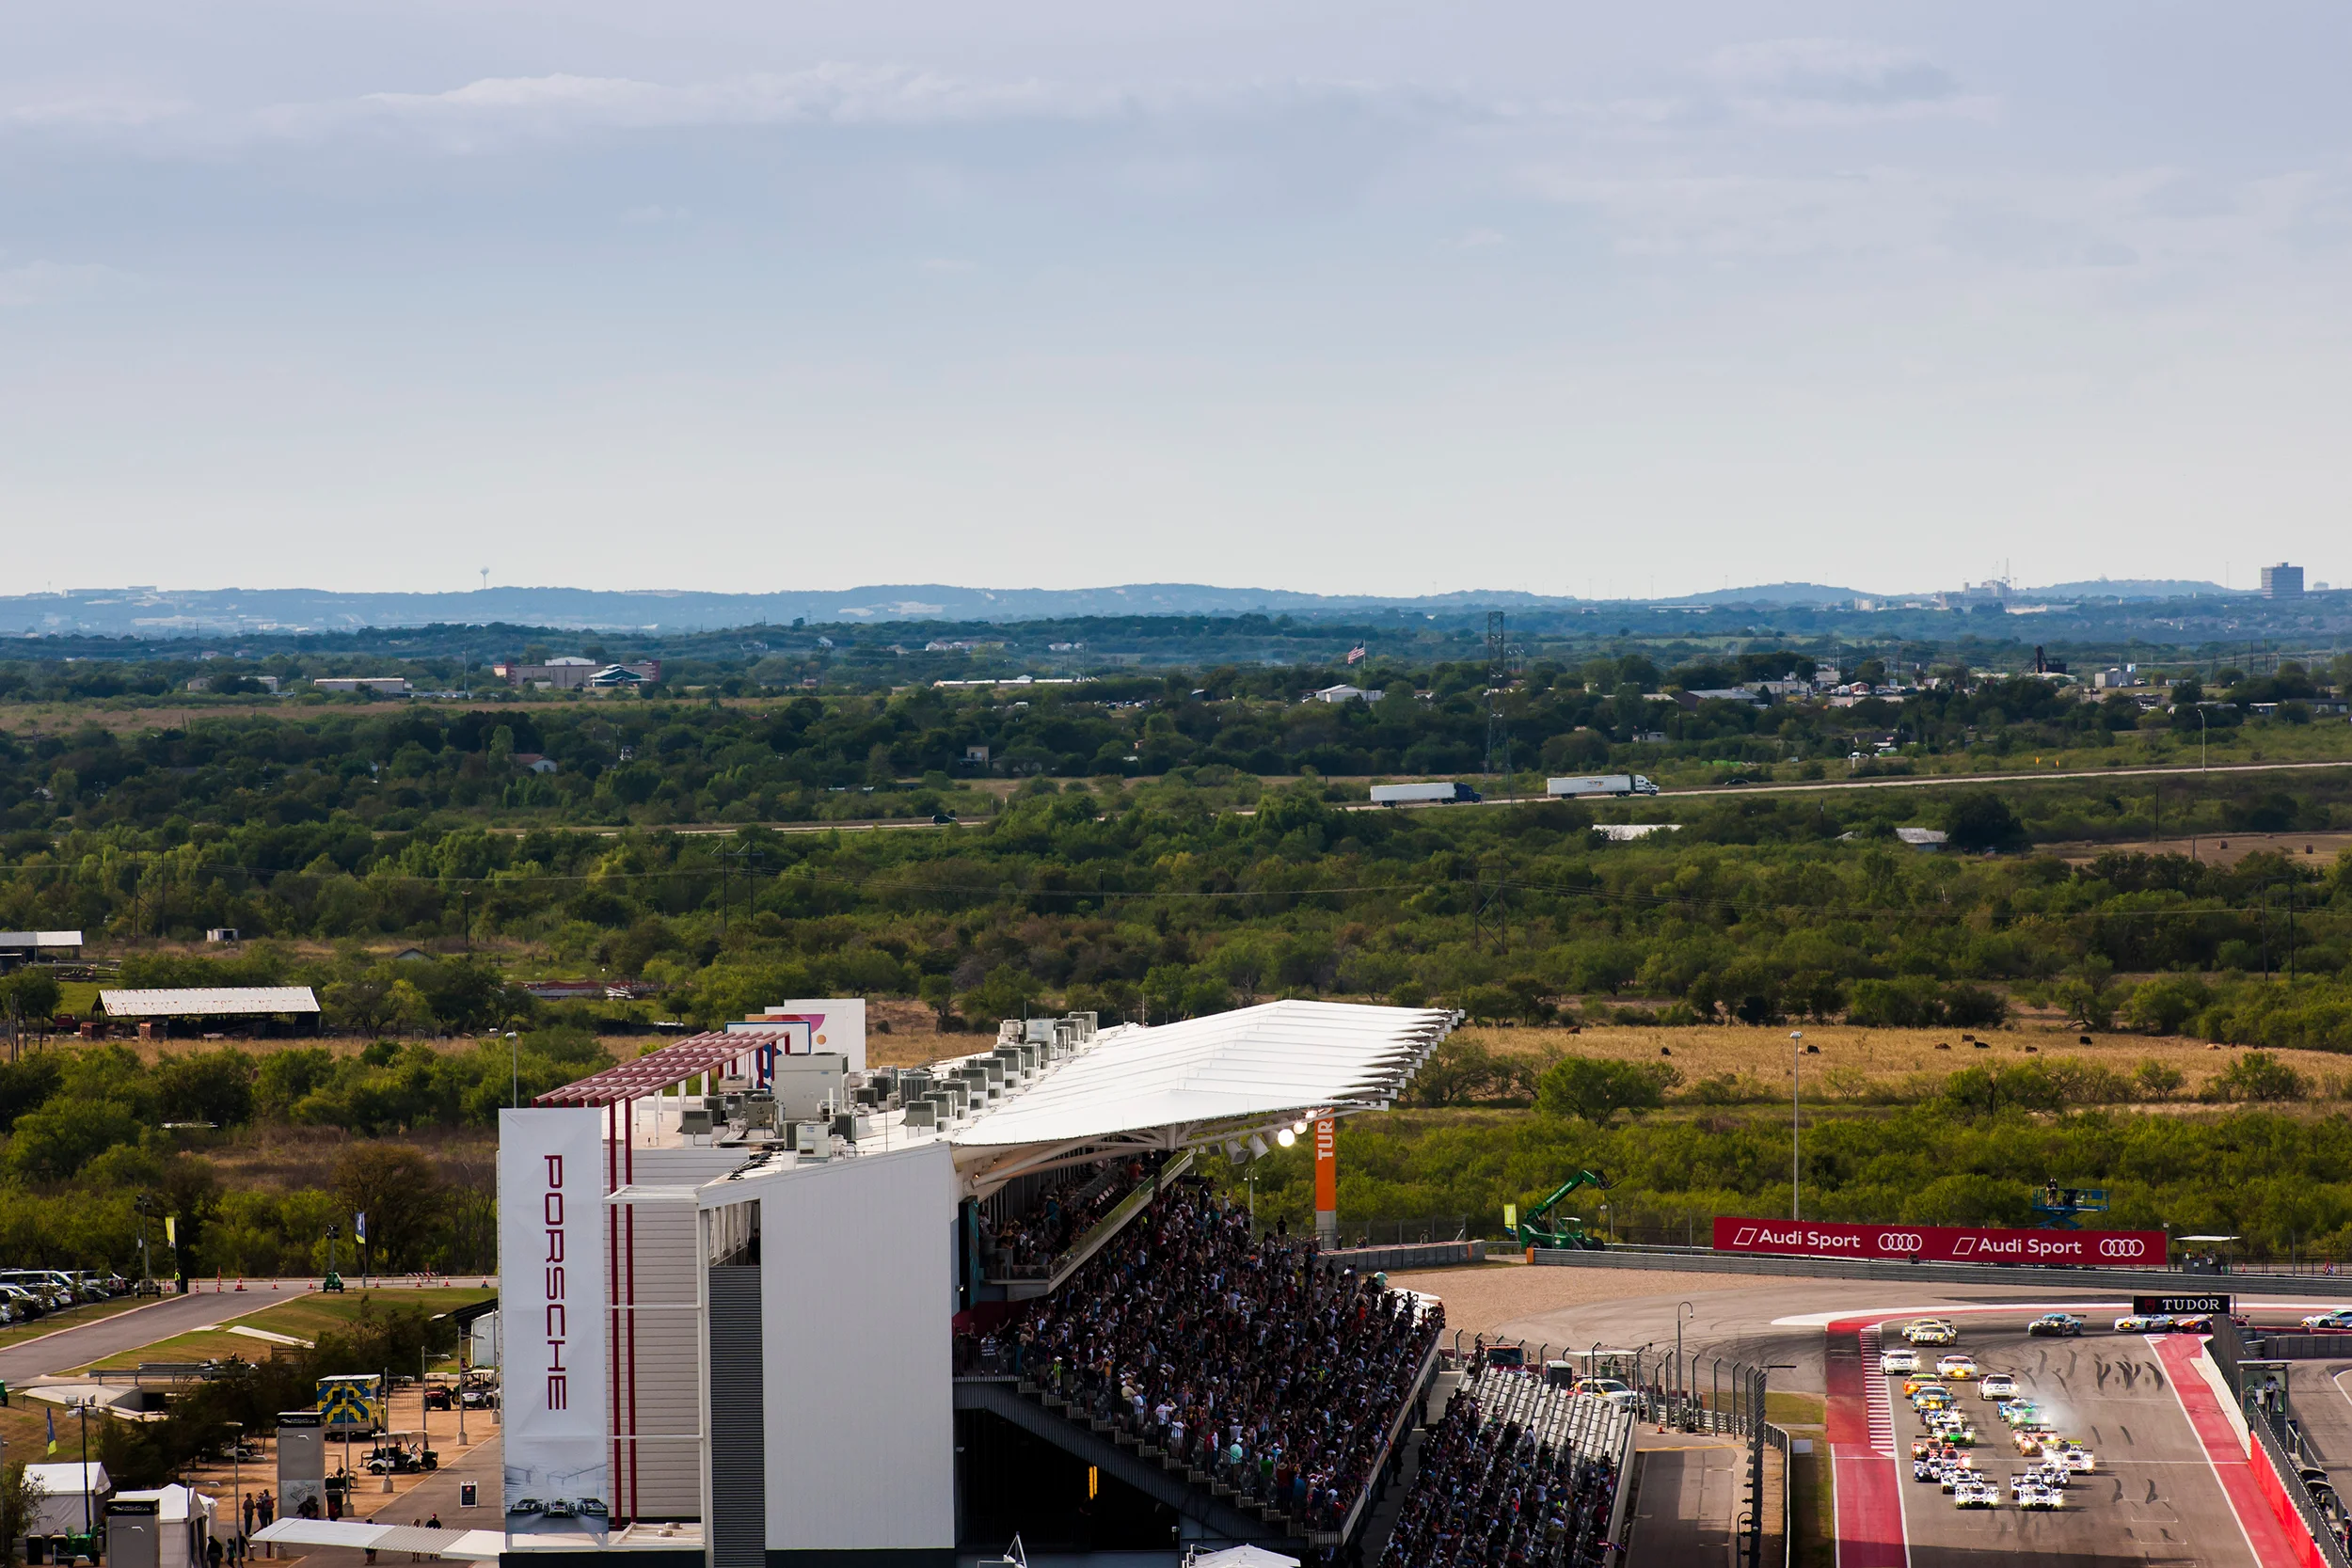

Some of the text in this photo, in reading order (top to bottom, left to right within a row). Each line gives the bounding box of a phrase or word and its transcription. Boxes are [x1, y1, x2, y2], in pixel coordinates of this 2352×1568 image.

[1758, 1228, 1861, 1249] Audi Sport
[1979, 1238, 2082, 1257] Audi Sport
[544, 1154, 567, 1411] PORSCHE
[2162, 1298, 2220, 1310] TUDOR
